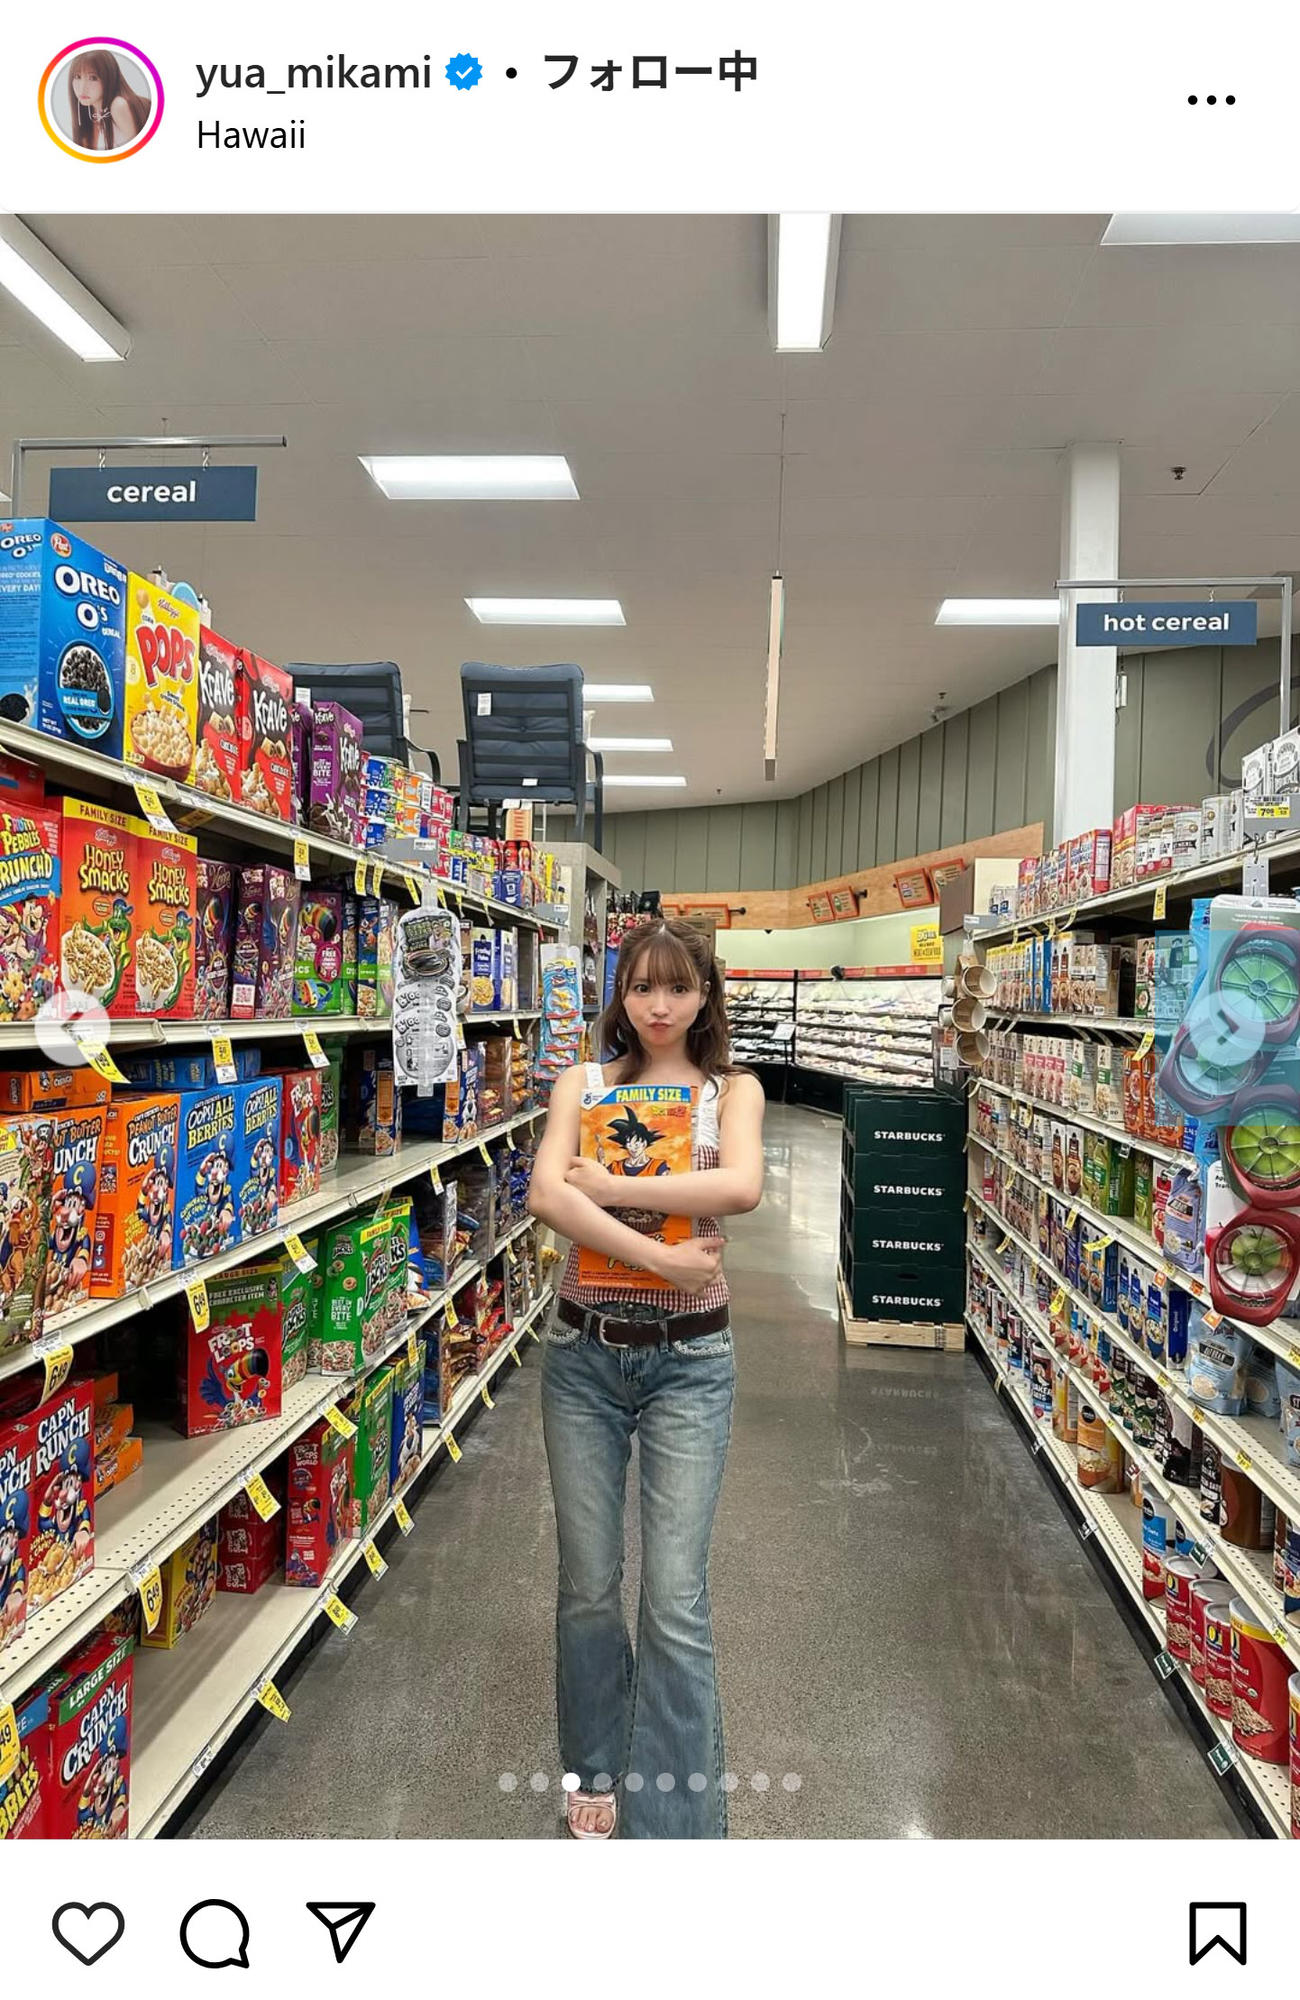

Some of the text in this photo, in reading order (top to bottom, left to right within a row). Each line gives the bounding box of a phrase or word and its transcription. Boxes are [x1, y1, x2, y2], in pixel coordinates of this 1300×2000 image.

[107, 480, 197, 503] cereal
[0, 533, 42, 549] OREO
[55, 566, 120, 605] OREO
[1103, 612, 1230, 631] hot cereal
[136, 625, 195, 687] POPS
[80, 804, 126, 826] FAMILY SIZE
[0, 830, 40, 855] PEBBLES
[149, 826, 188, 846] FAMILY SIZE
[0, 848, 52, 889] RUNCH'D
[84, 843, 124, 873] HONEY
[79, 864, 130, 895] SMACKS
[153, 860, 186, 886] HONEY
[148, 878, 189, 907] SMACKS
[213, 1094, 235, 1117] ALL
[264, 1086, 278, 1107] ALL
[616, 1087, 656, 1103] FAMILY
[658, 1087, 682, 1101] SIZE
[70, 1117, 101, 1143] BUTTER
[128, 1104, 178, 1139] PEANUT BUTTER
[245, 1103, 278, 1135] BERRIES
[266, 1122, 273, 1136] C
[187, 1113, 234, 1150] BERRIES
[218, 1134, 227, 1150] C
[873, 1130, 944, 1142] STARBUCKS
[53, 1136, 98, 1174] UNCH
[128, 1122, 176, 1167] CRUNCH
[160, 1148, 168, 1166] C
[73, 1165, 85, 1185] C
[873, 1184, 944, 1197] STARBUCKS
[871, 1239, 942, 1252] STARBUCKS
[228, 1284, 265, 1297] EXCLUSIVE
[247, 1291, 265, 1301] ITEM
[871, 1294, 942, 1308] STARBUCKS
[331, 1312, 352, 1321] BITE
[208, 1322, 252, 1353] FROOT
[214, 1336, 255, 1363] LOOPS
[38, 1397, 76, 1443] CAP'N
[35, 1406, 91, 1477] RUNCH
[68, 1444, 77, 1465] C
[5, 1497, 17, 1521] C
[69, 1645, 127, 1709] LARGE SIZE
[80, 1681, 115, 1738] CAP'N
[63, 1682, 127, 1782] CRUNCH
[107, 1724, 116, 1748] C
